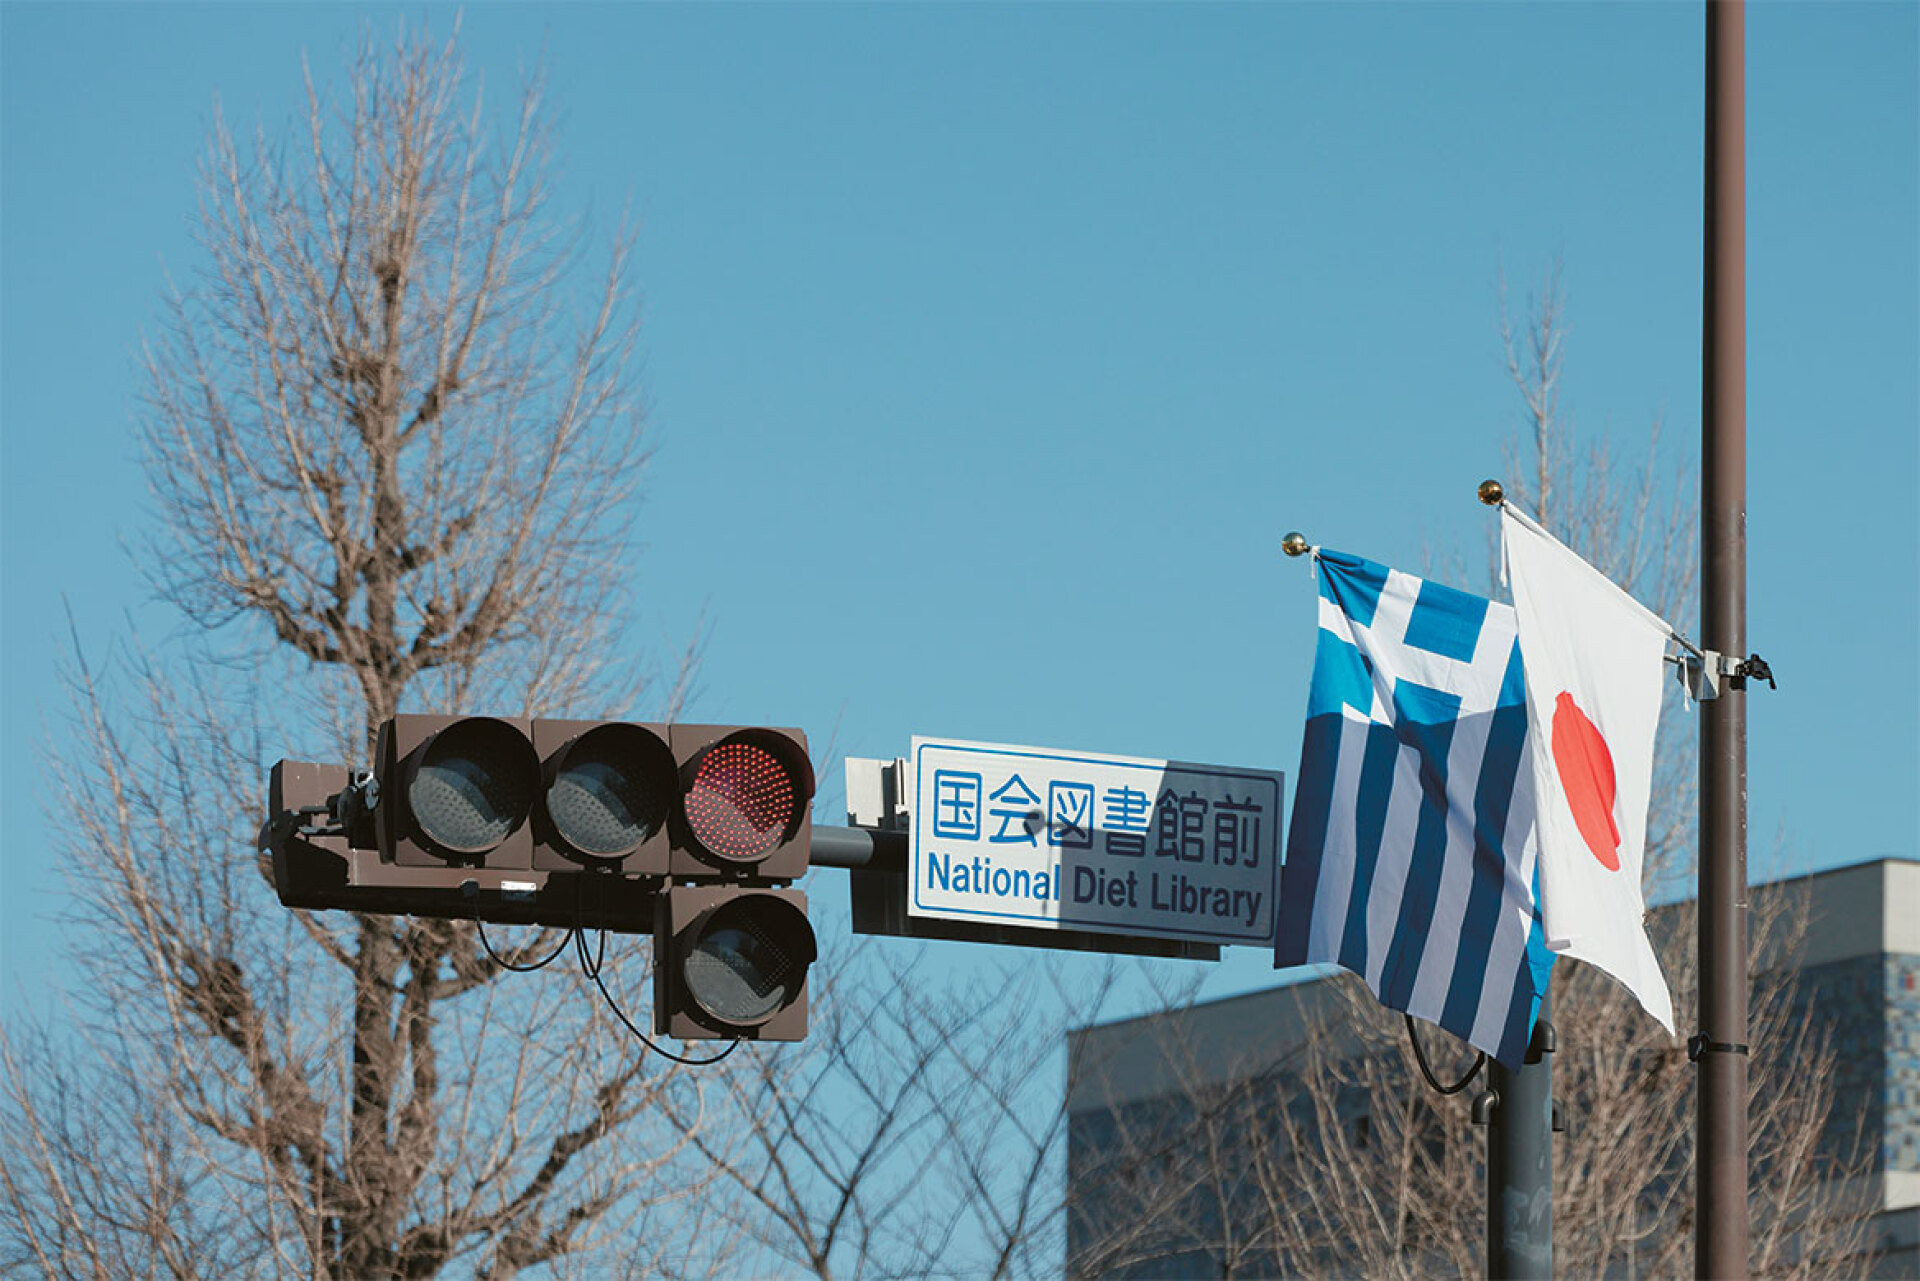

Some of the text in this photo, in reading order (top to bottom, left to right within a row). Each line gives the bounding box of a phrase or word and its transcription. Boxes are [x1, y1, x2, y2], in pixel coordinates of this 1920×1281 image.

[933, 769, 1263, 869] 国会図書館前
[928, 852, 1262, 928] National Diet Library
